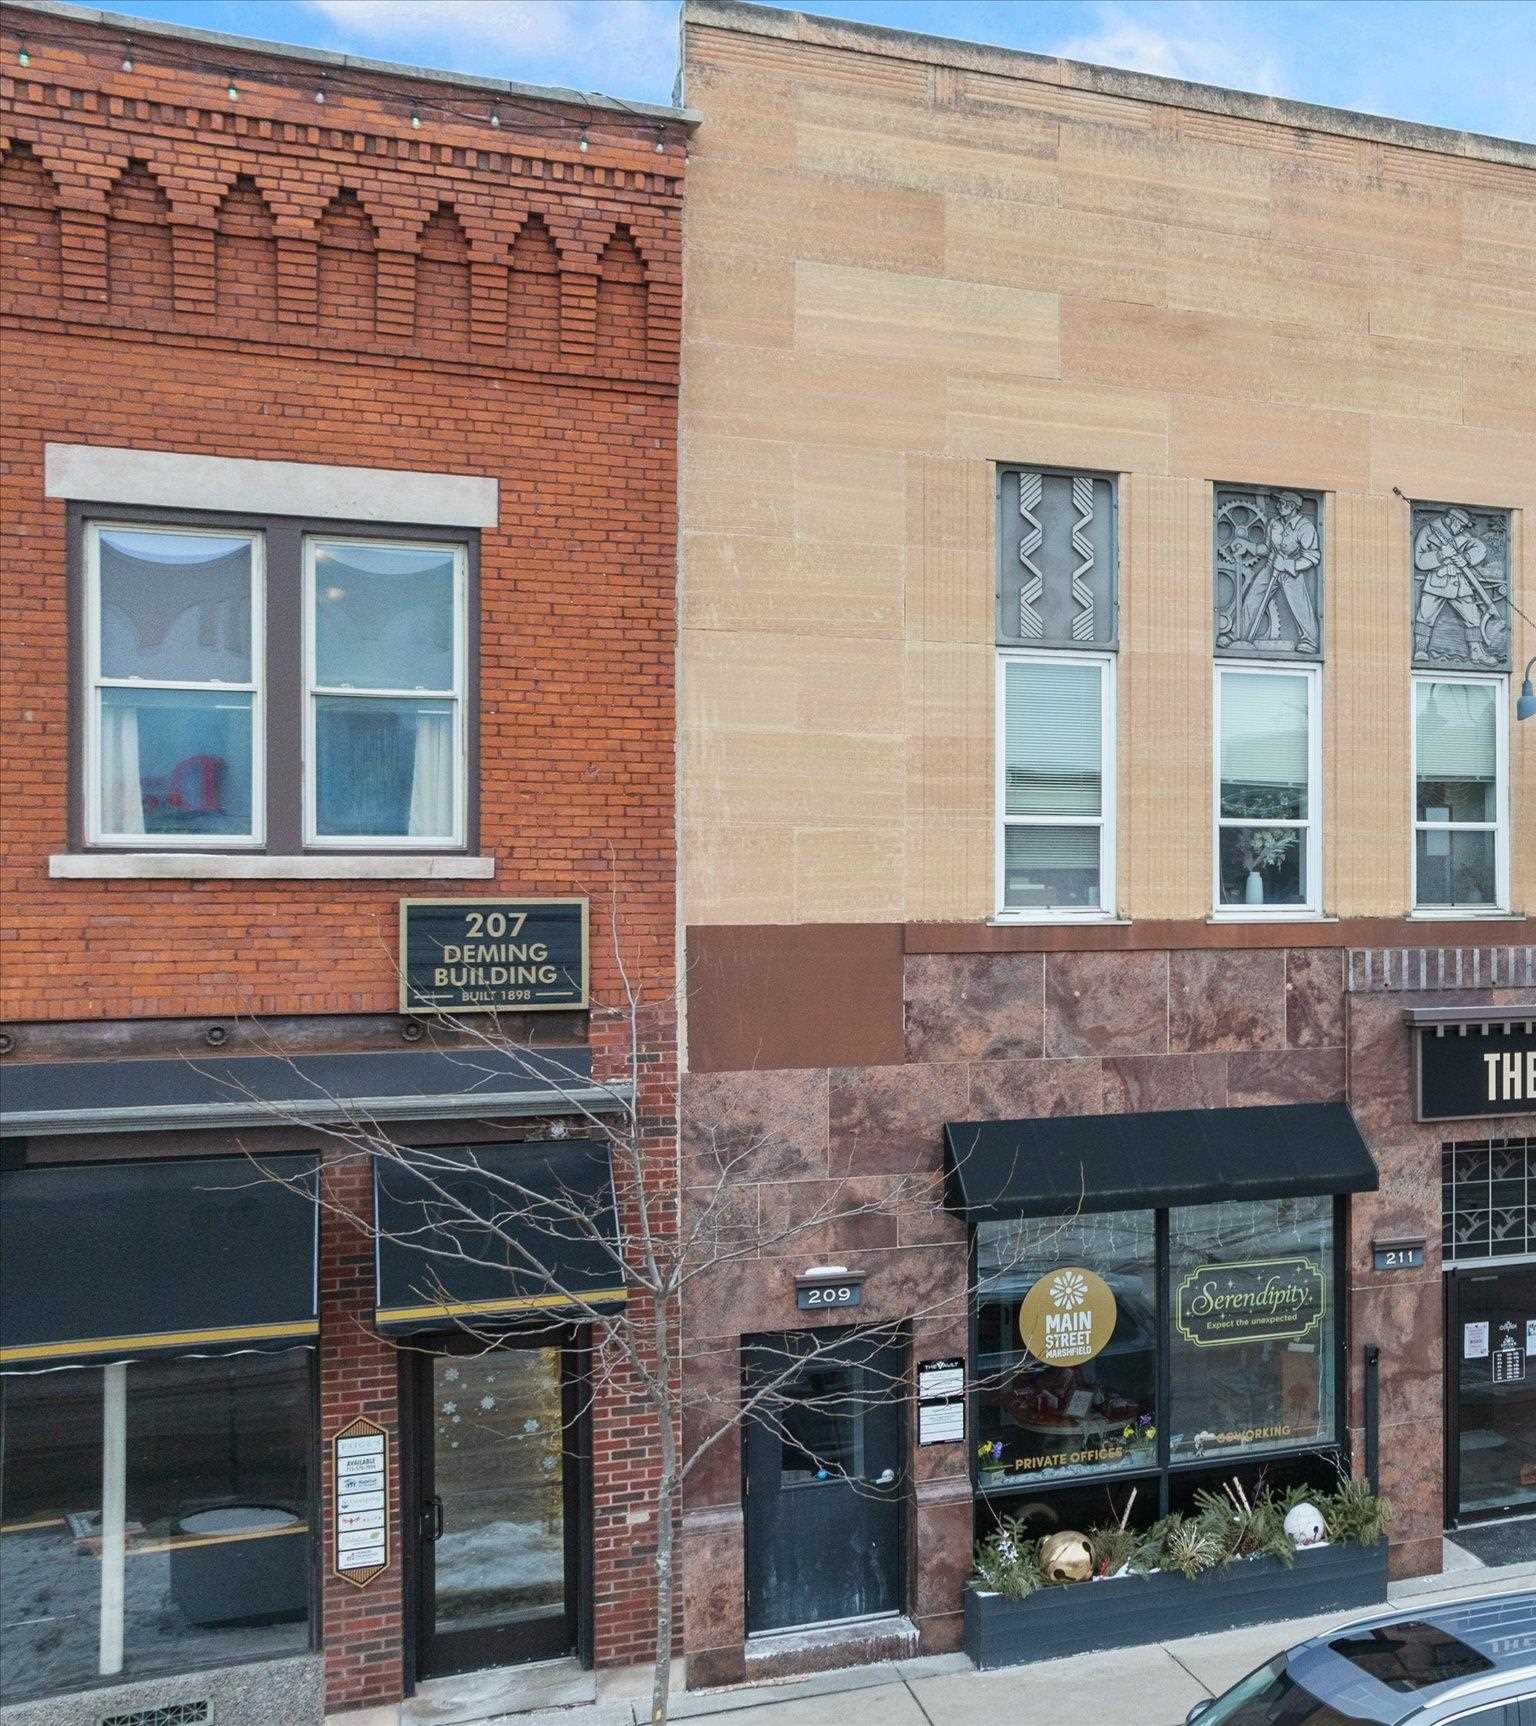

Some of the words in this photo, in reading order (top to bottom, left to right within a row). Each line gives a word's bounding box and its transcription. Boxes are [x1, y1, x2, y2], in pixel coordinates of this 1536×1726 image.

[466, 912, 528, 938] 207
[444, 942, 549, 963] DEMING
[435, 965, 557, 987] BUILDING
[462, 991, 495, 1001] BUILT
[501, 990, 531, 1000] 1898
[1385, 1251, 1414, 1265] 211
[808, 1288, 851, 1304] 209
[1192, 1275, 1309, 1316] Serendipity
[1046, 1311, 1092, 1333] MAIN
[1207, 1321, 1235, 1330] Expect
[1251, 1314, 1298, 1325] unexpected
[1046, 1330, 1092, 1348] STREET
[1046, 1346, 1092, 1358] MARSHFIELD
[1216, 1425, 1291, 1443] COWORKING
[1015, 1453, 1068, 1470] PRIVATE
[1070, 1446, 1123, 1463] OFFICES
